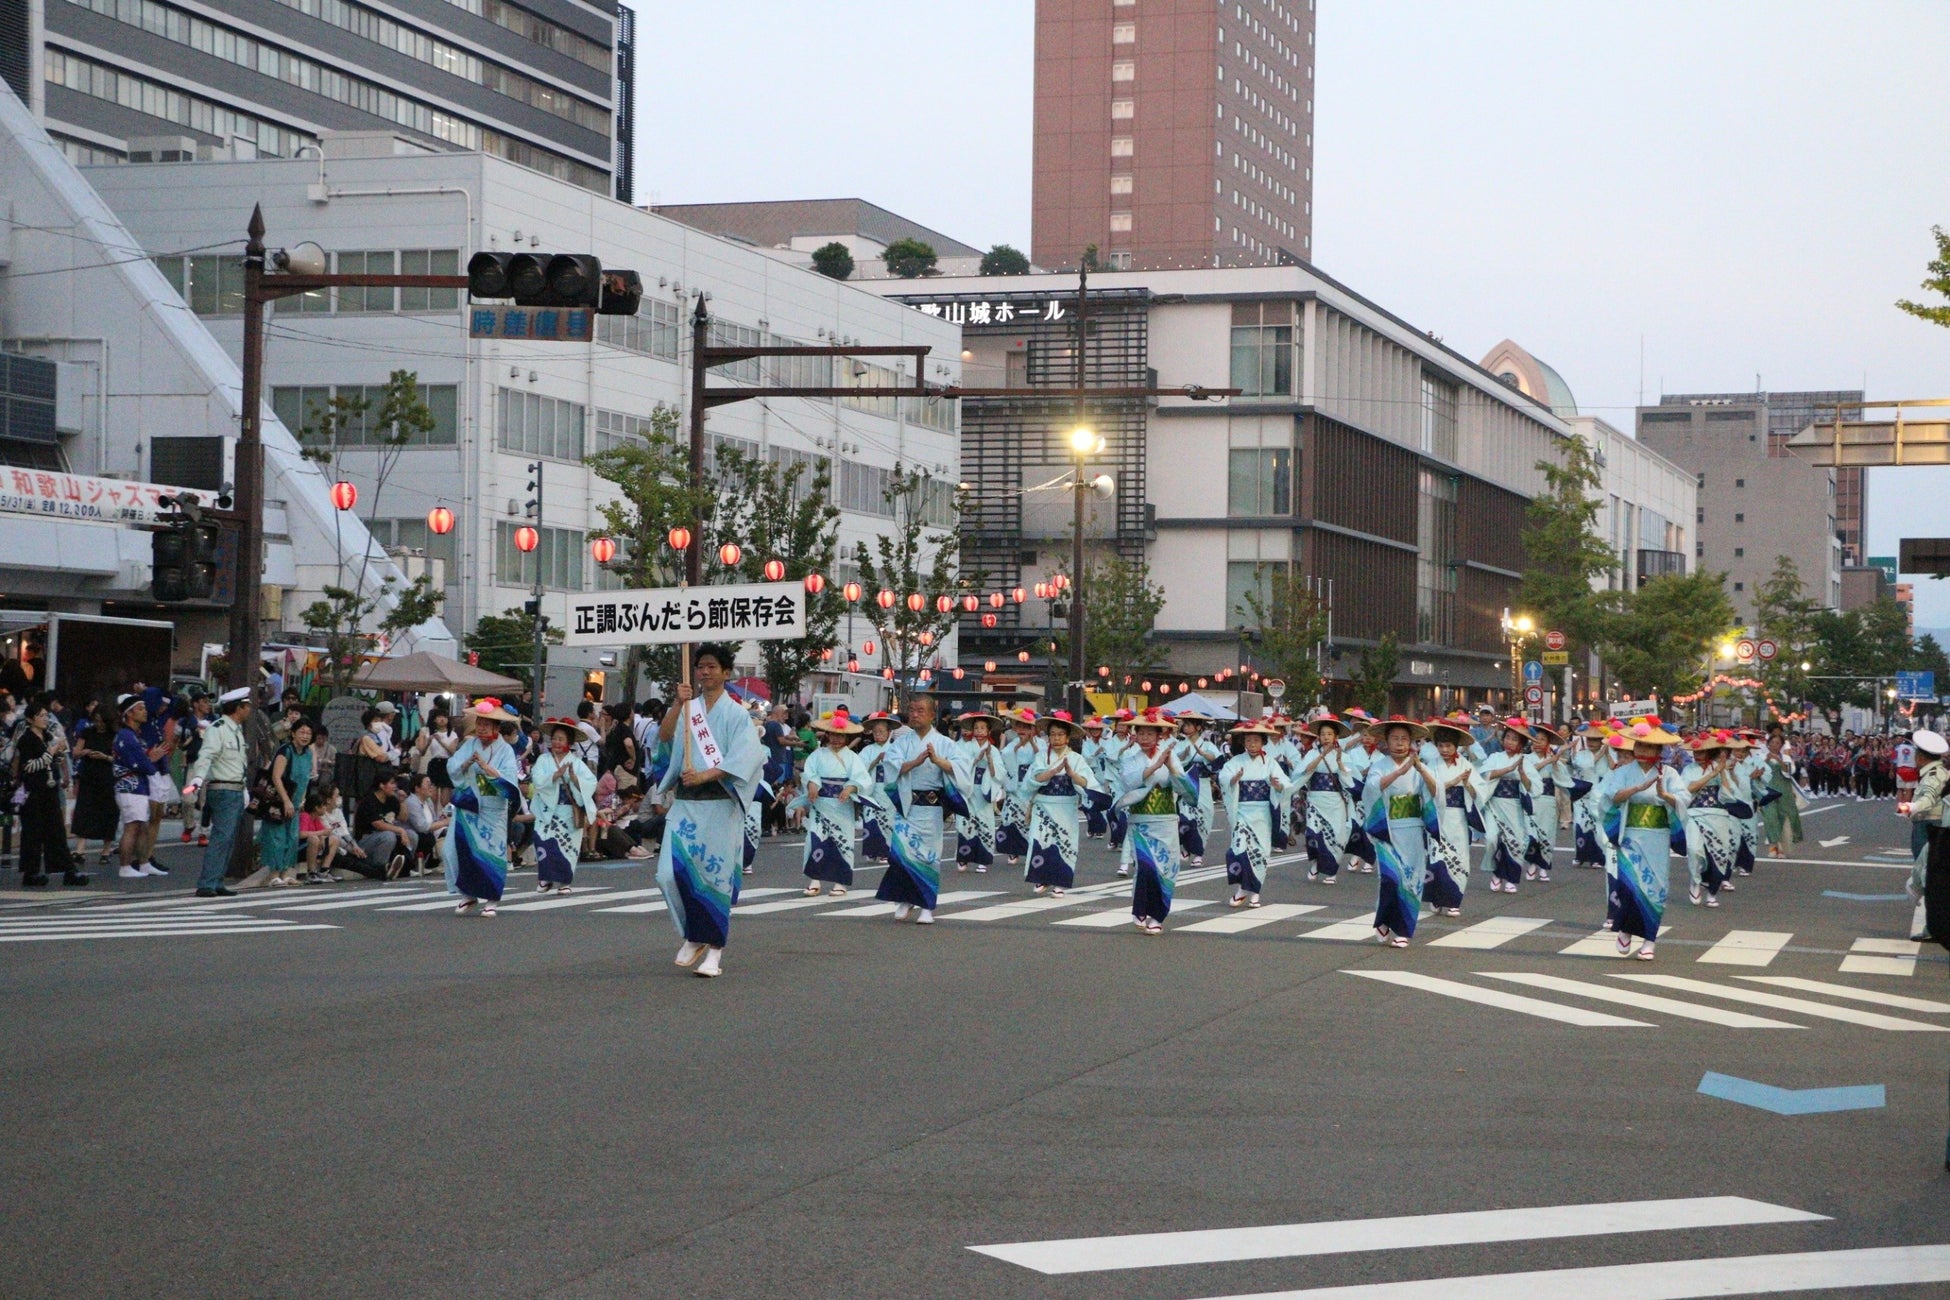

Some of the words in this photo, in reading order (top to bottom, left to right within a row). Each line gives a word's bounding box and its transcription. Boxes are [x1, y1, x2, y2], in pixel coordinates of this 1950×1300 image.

[575, 594, 795, 634] 正調ぶんだら節保存会
